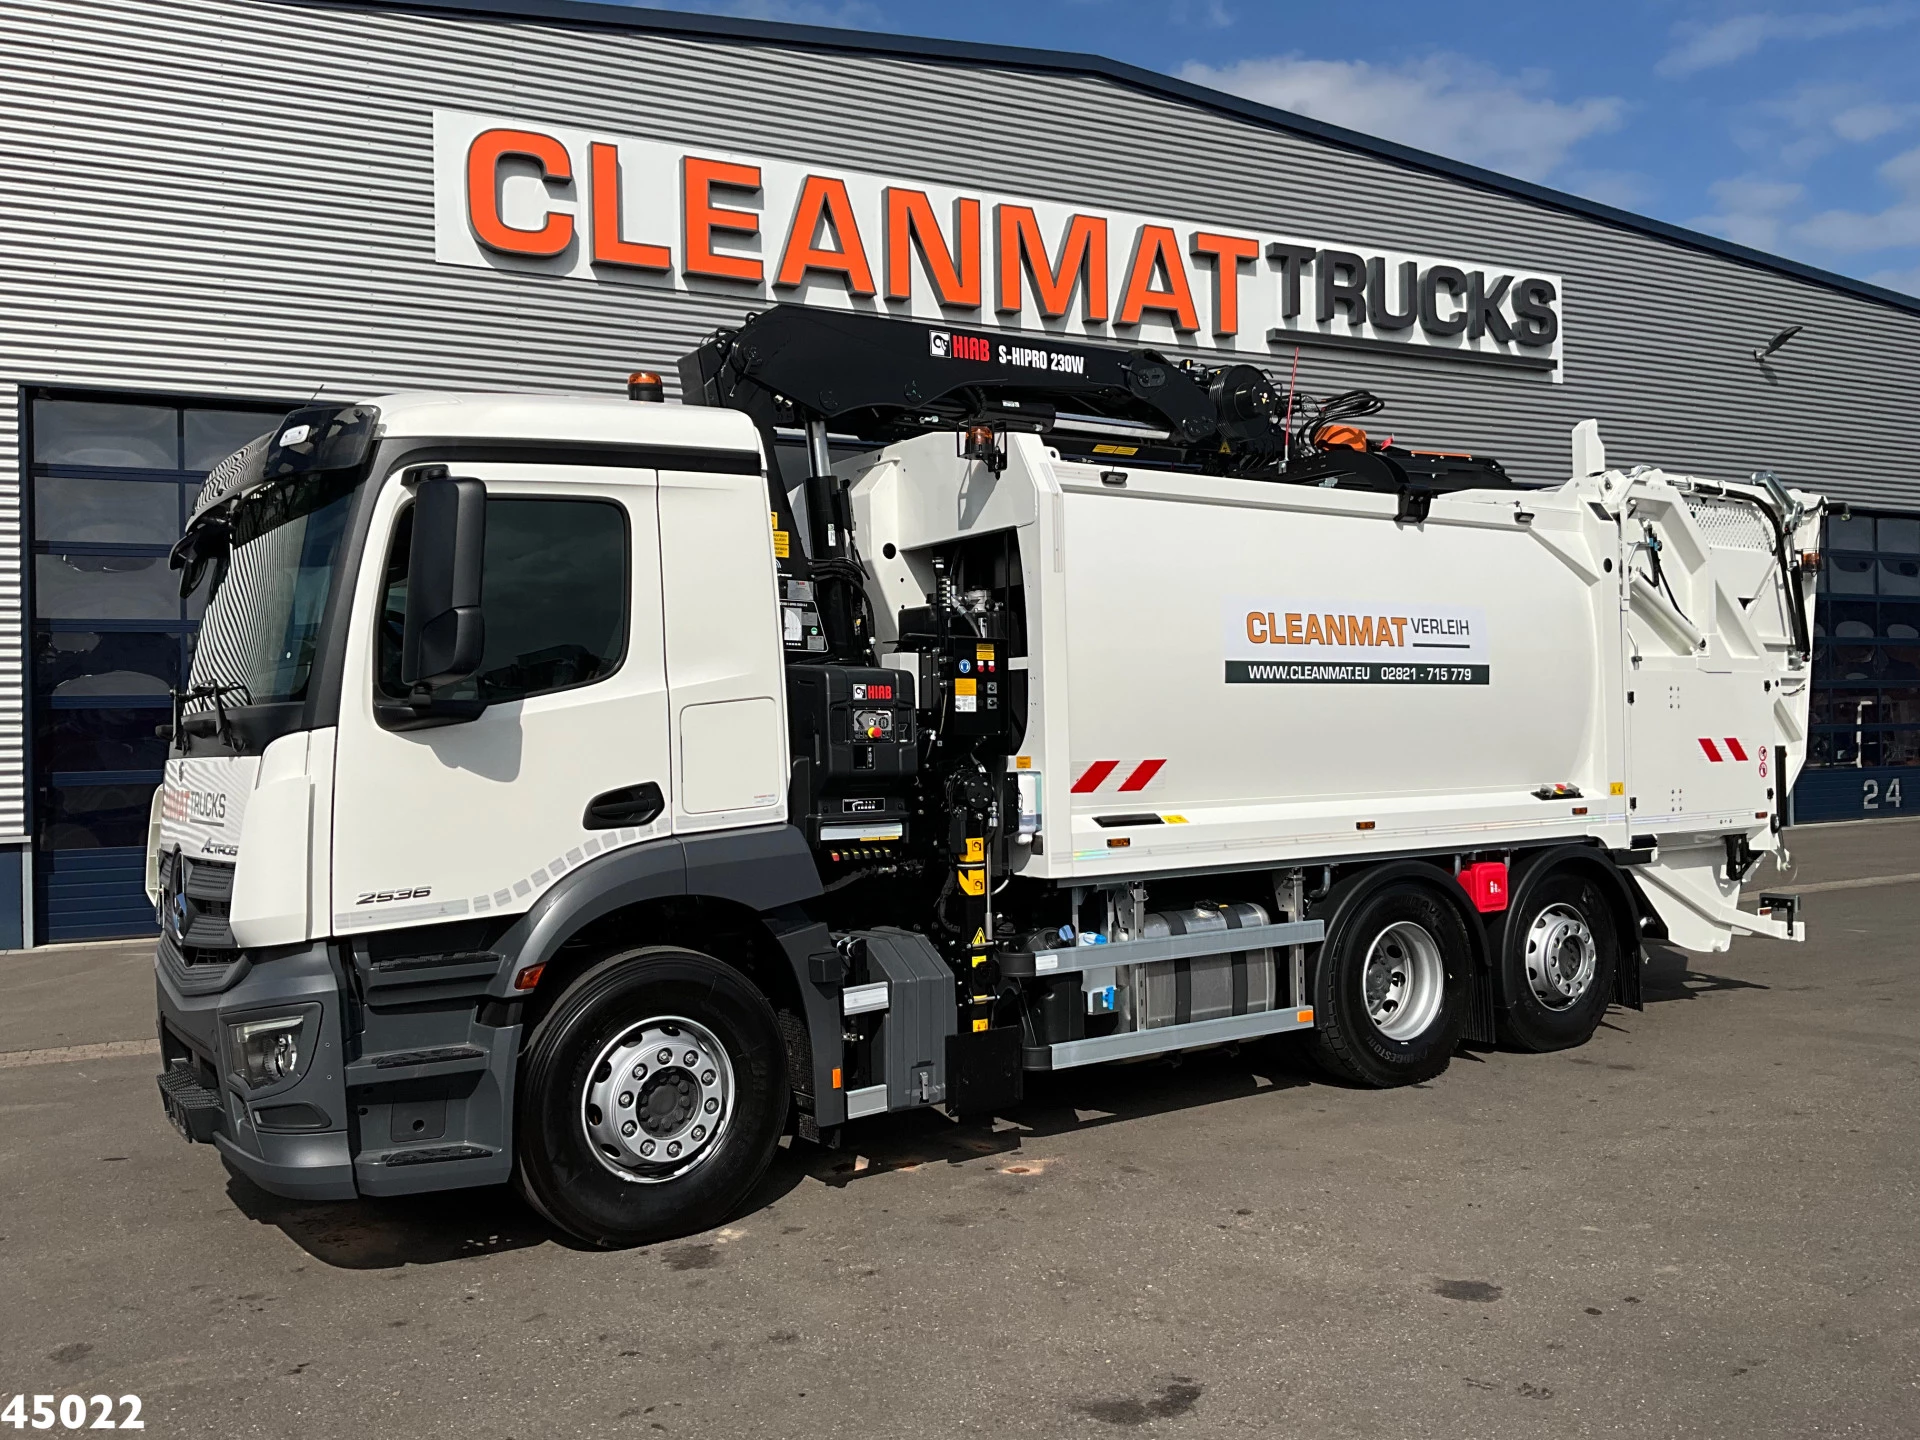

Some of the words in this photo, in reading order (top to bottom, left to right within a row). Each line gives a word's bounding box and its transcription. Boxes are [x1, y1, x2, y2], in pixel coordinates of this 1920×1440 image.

[465, 128, 1259, 338] CLEANMAT
[1266, 242, 1558, 347] TRUCKS
[952, 335, 990, 361] HIAB
[998, 345, 1047, 369] S-HIPRO
[1050, 352, 1085, 374] 230W
[1246, 611, 1407, 647] CLEANMAT
[1411, 617, 1470, 635] VERLEIH
[1248, 665, 1370, 680] WWW.CLEANMAT.EU
[1381, 667, 1416, 681] 02821
[1427, 667, 1448, 681] 715
[1451, 668, 1471, 681] 779
[867, 685, 892, 699] HIAB
[190, 791, 226, 818] TRUCKS
[1863, 778, 1901, 809] 24
[356, 886, 432, 905] 2536
